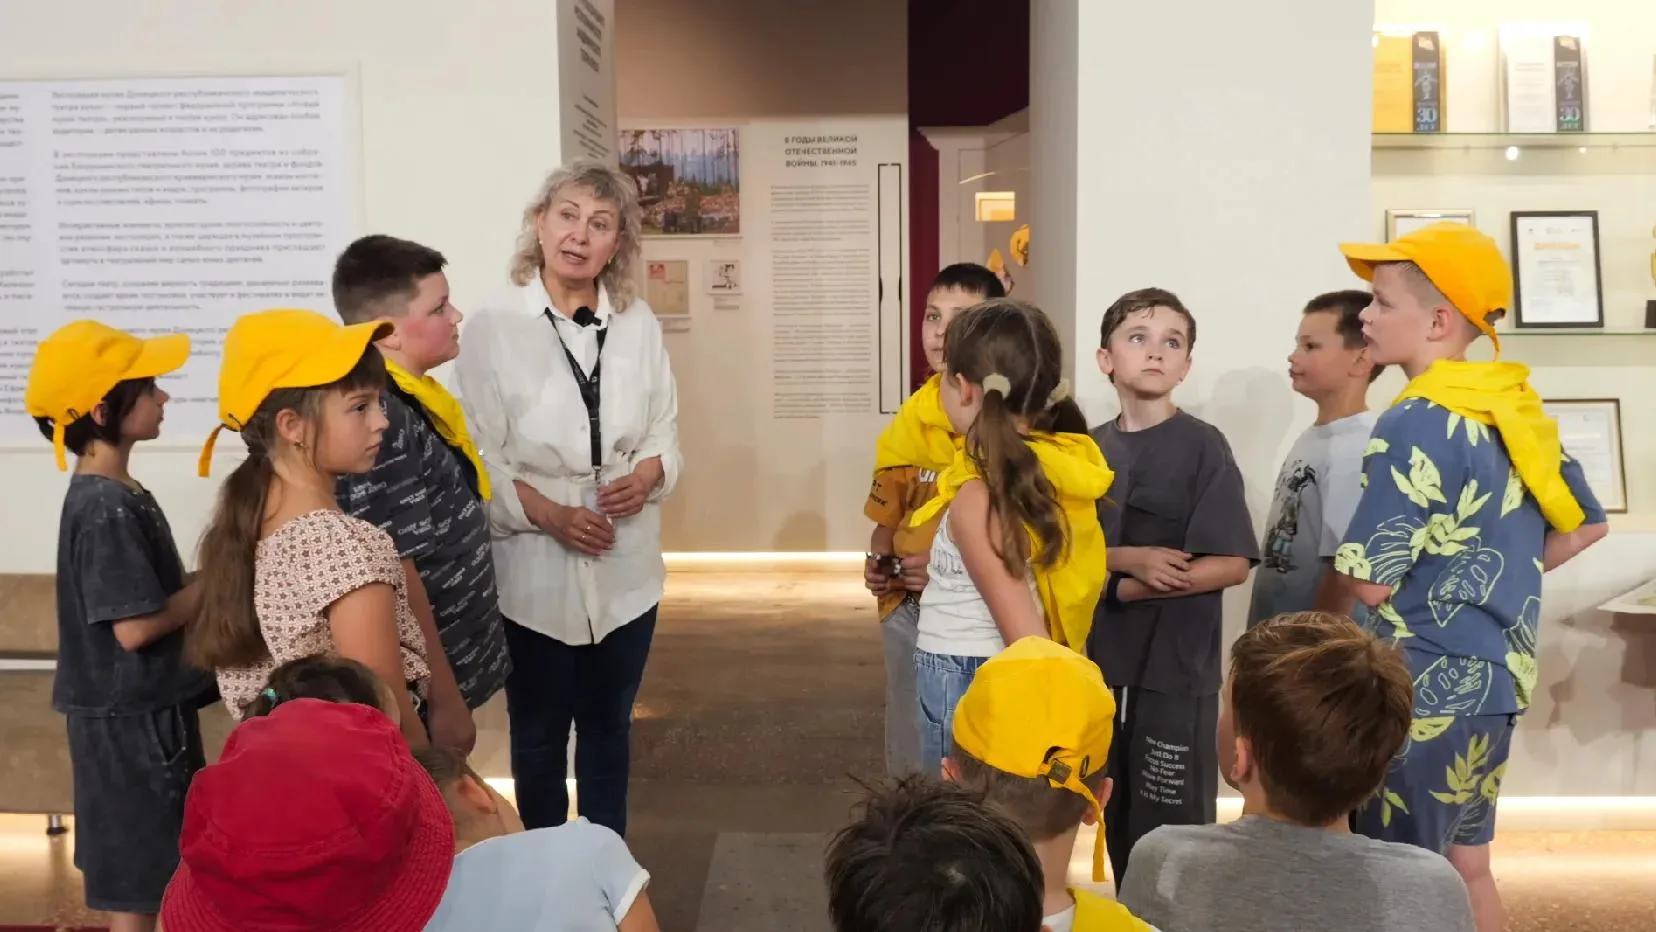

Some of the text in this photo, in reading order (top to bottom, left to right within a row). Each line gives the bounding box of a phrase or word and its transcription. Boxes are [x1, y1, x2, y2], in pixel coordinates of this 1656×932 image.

[1417, 107, 1438, 122] 30
[791, 136, 815, 144] ГОДЫ
[817, 135, 858, 143] ВЕЛИКОЙ
[785, 147, 857, 155] ОТЕЧЕСТВЕННОЙ
[1157, 741, 1190, 752] Champion
[1163, 752, 1172, 760] Do
[1160, 760, 1185, 770] Success
